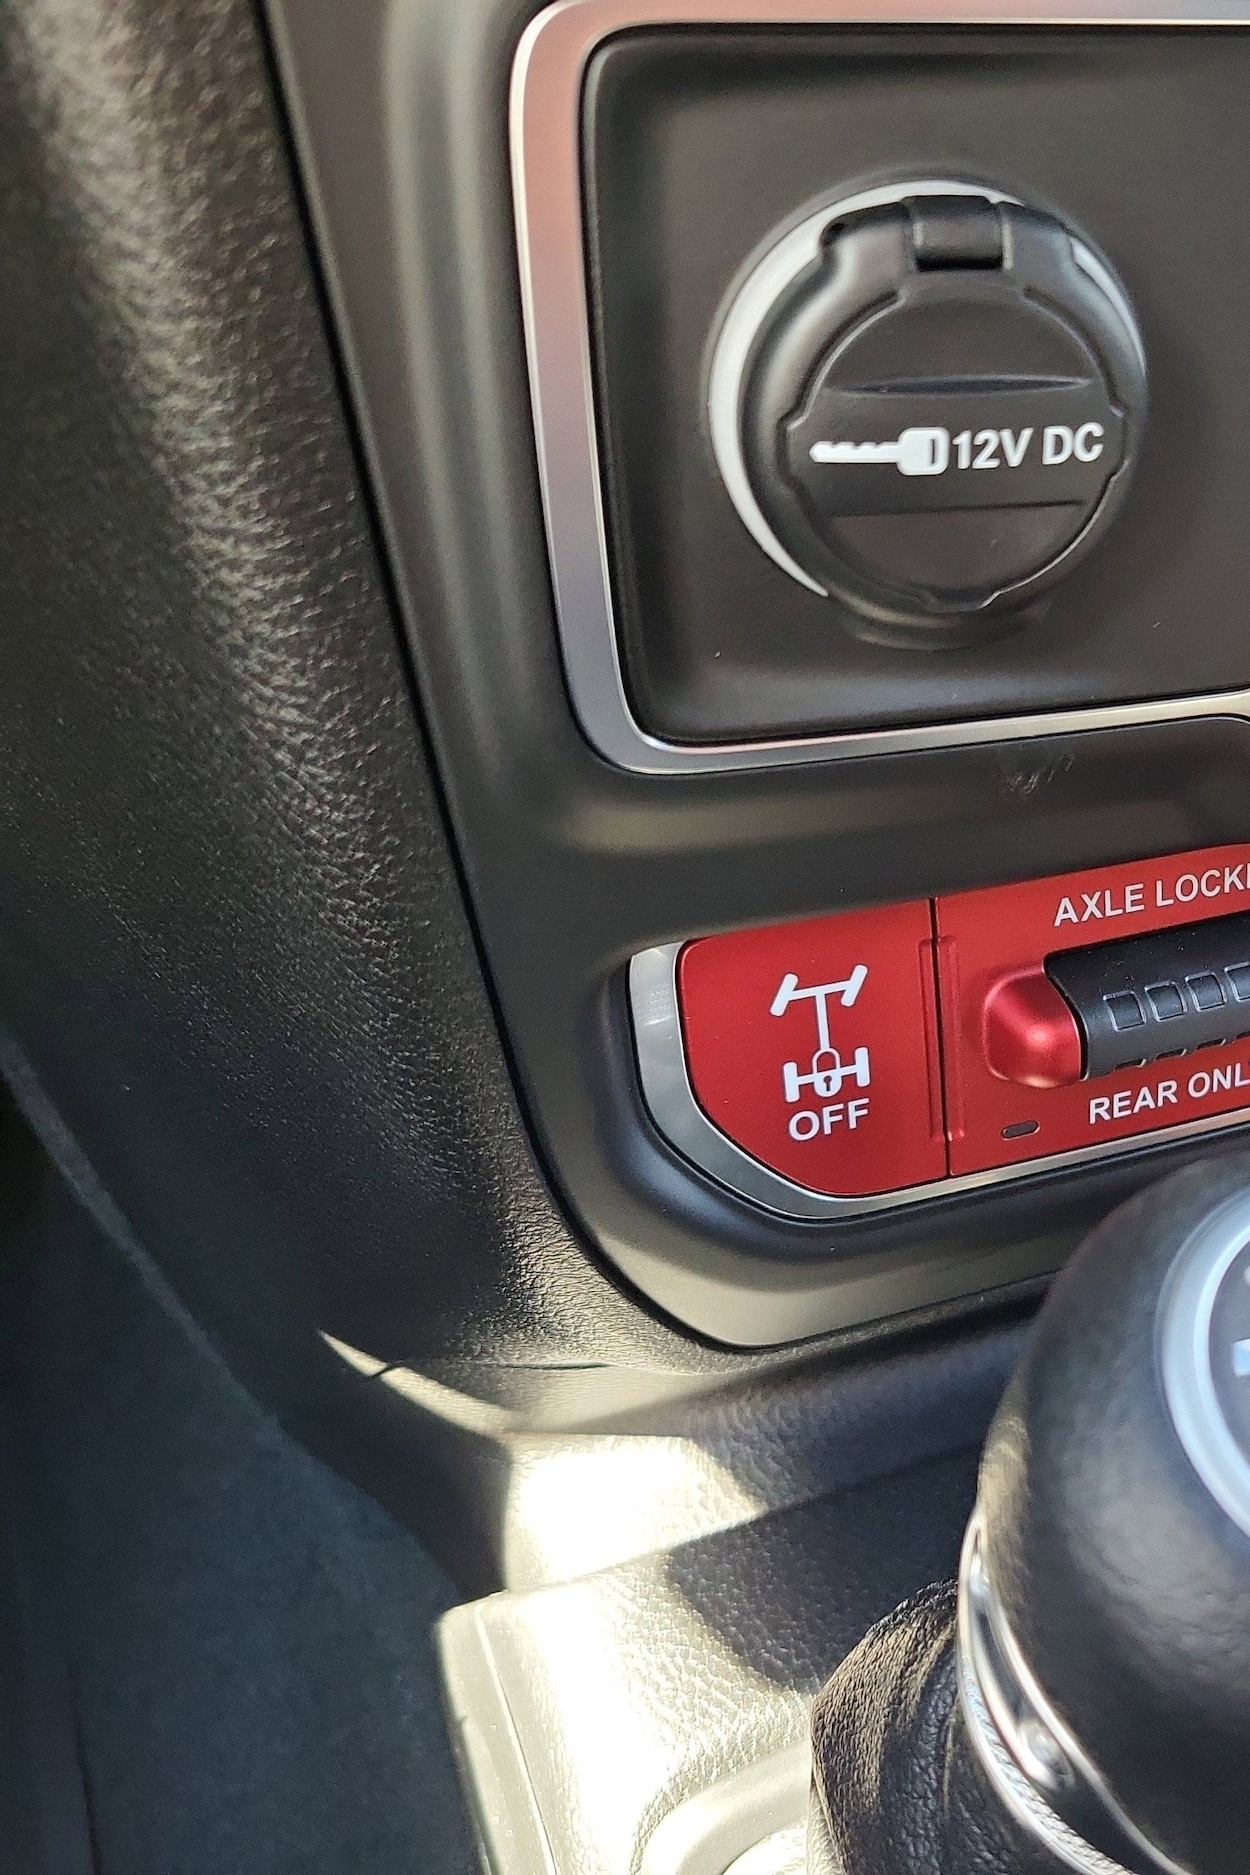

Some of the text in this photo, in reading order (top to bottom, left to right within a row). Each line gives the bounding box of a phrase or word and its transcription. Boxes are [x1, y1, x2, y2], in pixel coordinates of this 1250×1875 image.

[952, 422, 1105, 470] 12V DC
[1053, 883, 1145, 927] AXLE
[788, 1097, 870, 1141] OFF
[1089, 1080, 1179, 1125] REAR
